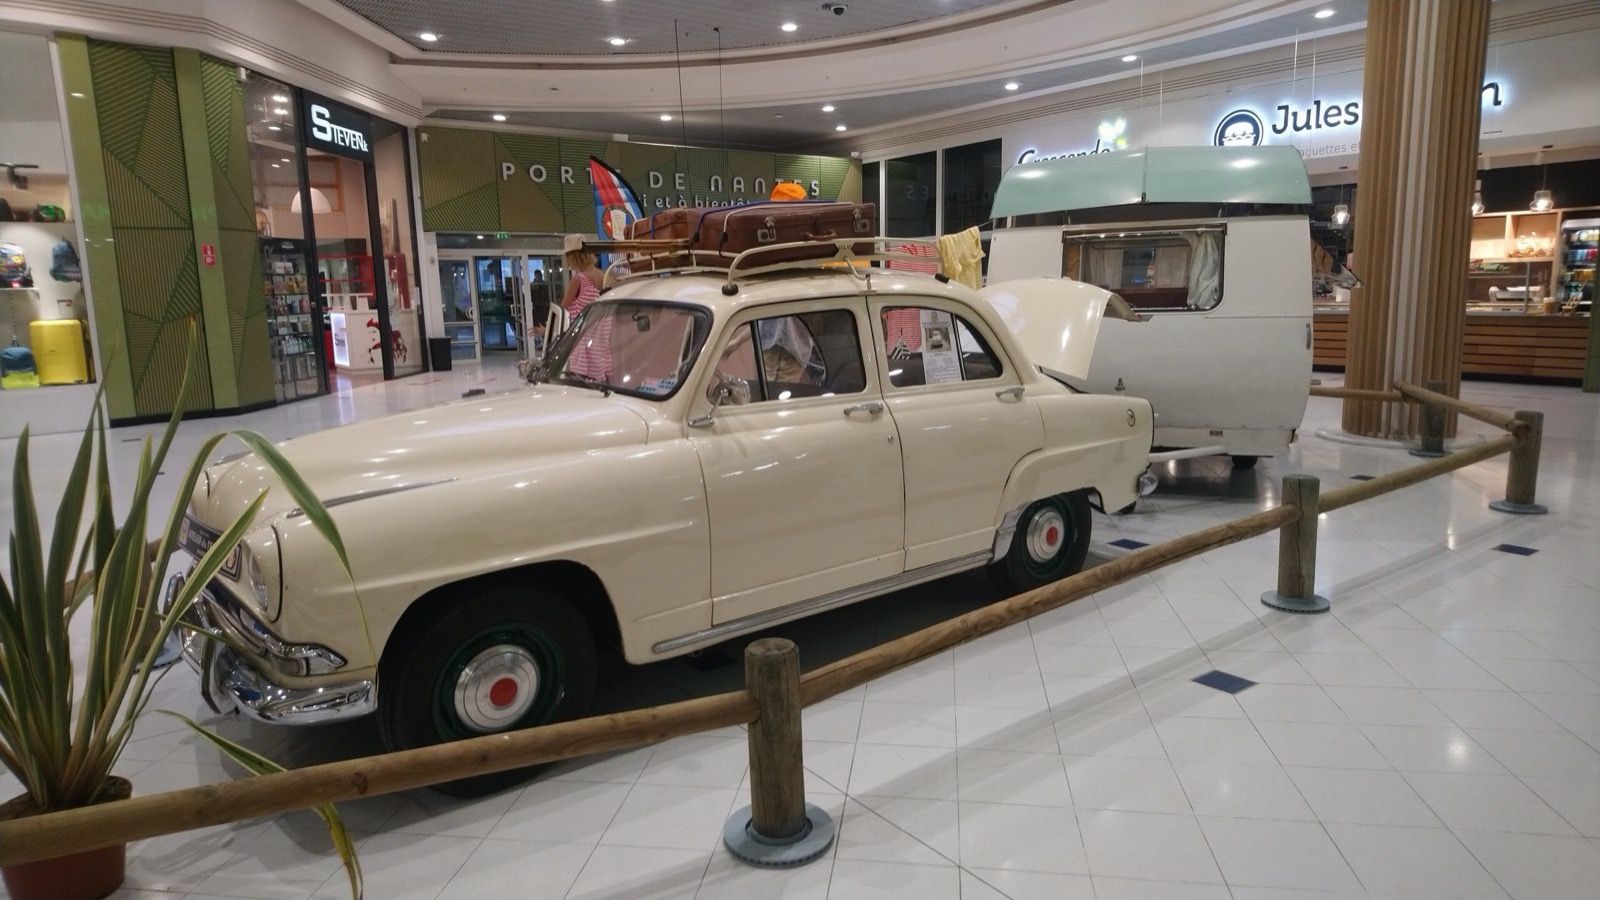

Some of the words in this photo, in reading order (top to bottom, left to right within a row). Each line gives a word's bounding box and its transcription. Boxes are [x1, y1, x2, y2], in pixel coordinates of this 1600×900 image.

[1272, 100, 1359, 134] Jules
[1300, 144, 1347, 158] aguettes
[502, 162, 621, 184] PORT
[649, 171, 686, 190] DE
[711, 175, 820, 196] NANS
[656, 195, 671, 208] et
[678, 194, 688, 208] à
